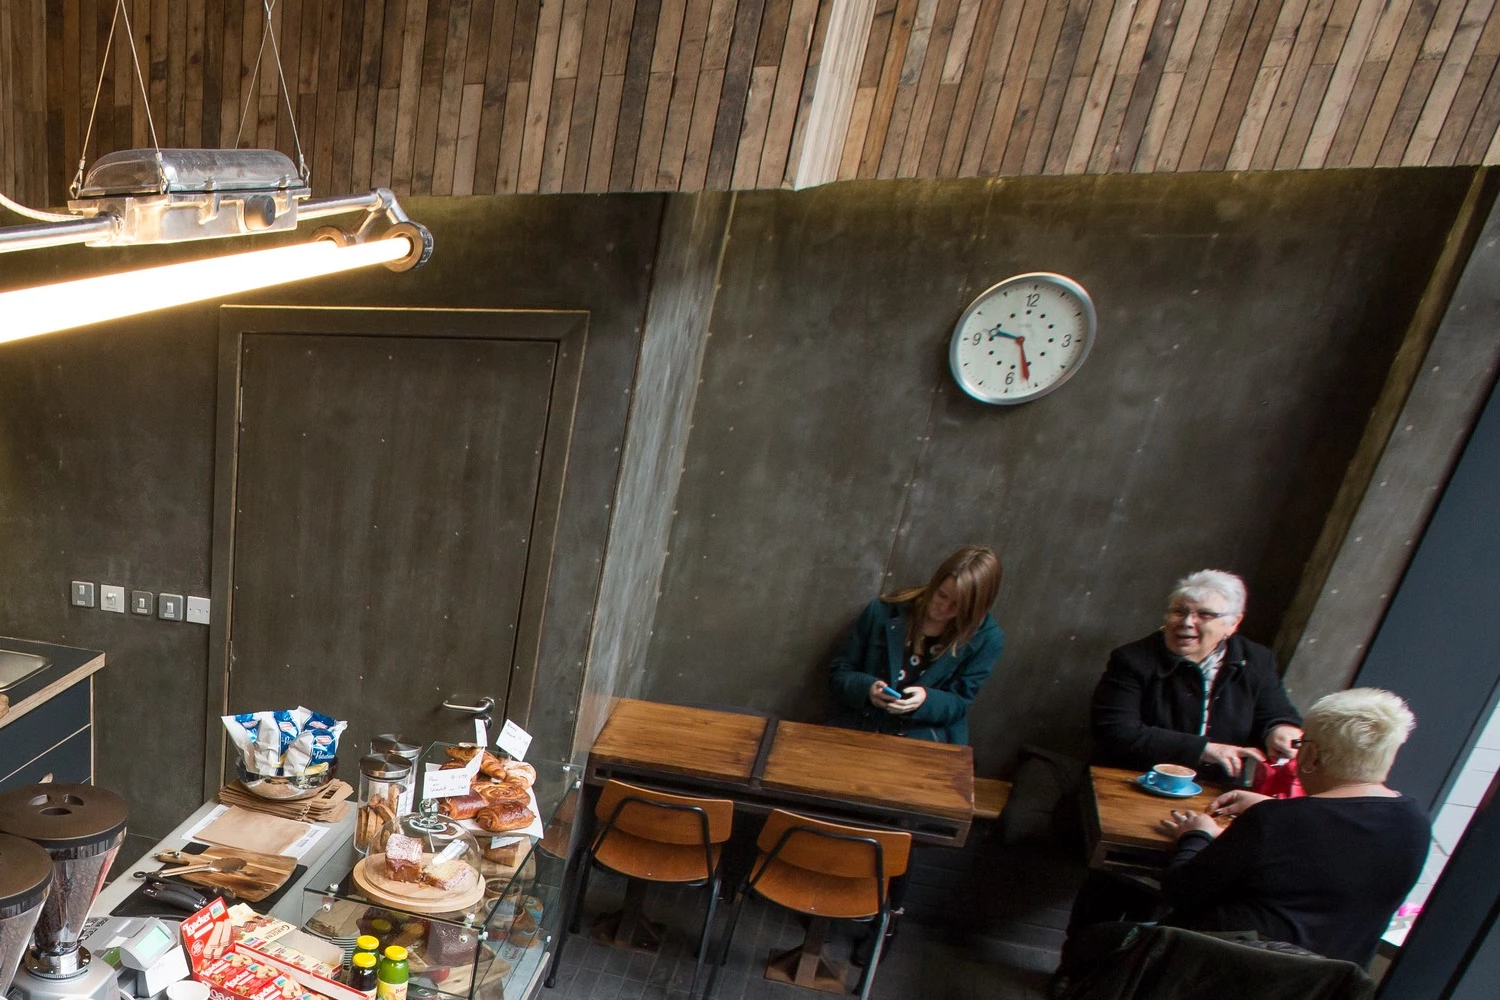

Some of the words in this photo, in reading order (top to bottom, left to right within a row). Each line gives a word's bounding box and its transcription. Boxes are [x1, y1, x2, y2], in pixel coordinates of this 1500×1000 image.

[1026, 294, 1040, 307] 12
[972, 333, 981, 346] 9
[1061, 334, 1072, 348] 3
[1005, 372, 1014, 385] 6
